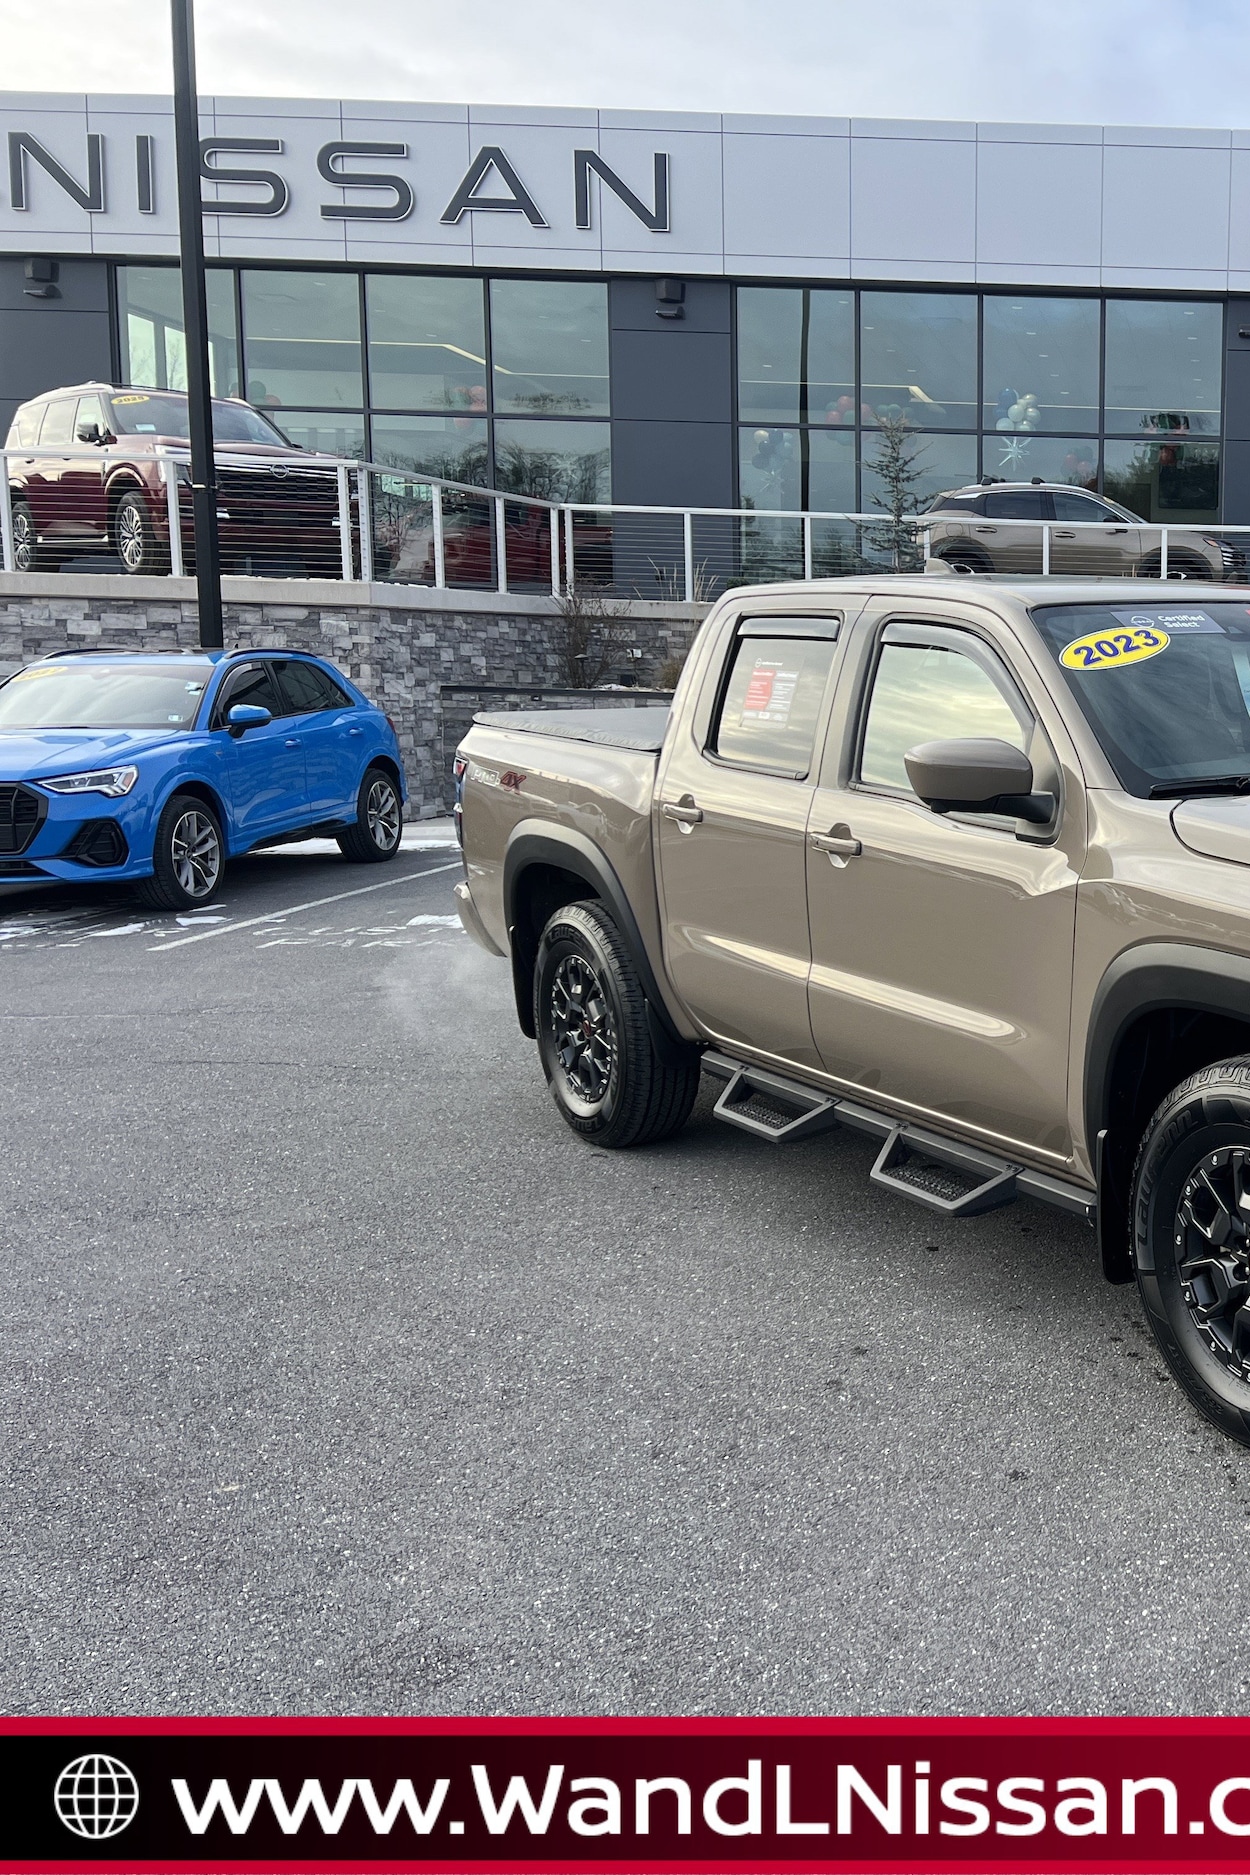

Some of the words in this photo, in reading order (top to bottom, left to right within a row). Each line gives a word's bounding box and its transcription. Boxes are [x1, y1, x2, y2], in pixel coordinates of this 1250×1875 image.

[8, 131, 670, 232] NISSAN
[1157, 614, 1205, 623] Certified
[1163, 621, 1201, 629] Select
[1073, 629, 1162, 667] 2023
